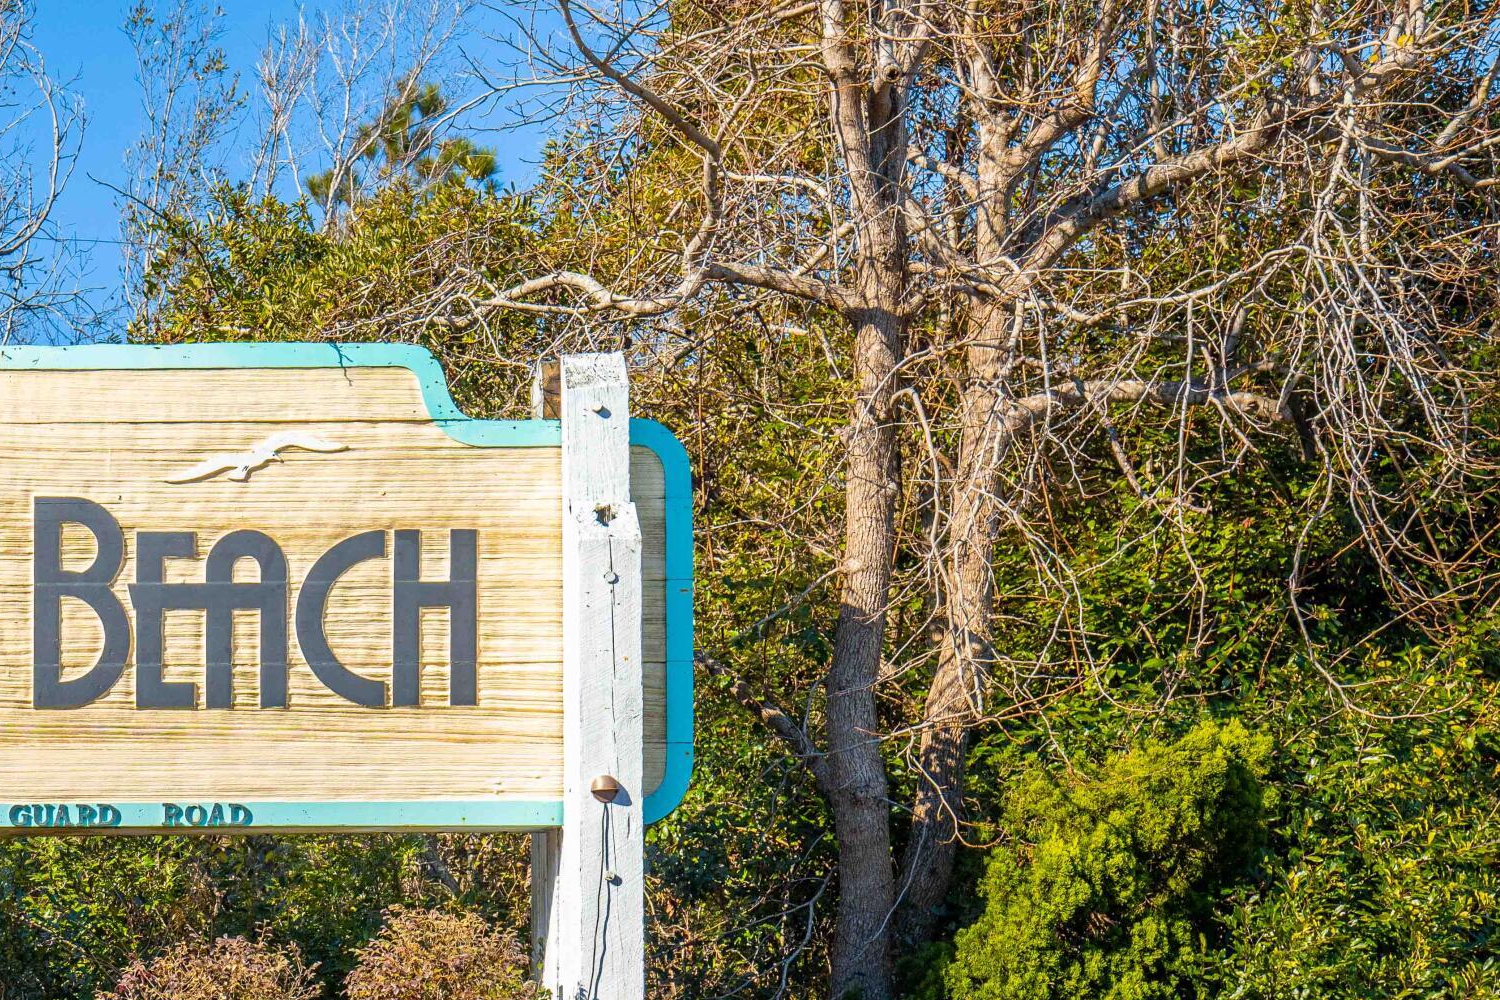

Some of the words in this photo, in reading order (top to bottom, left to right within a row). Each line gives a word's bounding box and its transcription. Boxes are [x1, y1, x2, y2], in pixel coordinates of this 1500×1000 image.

[33, 495, 478, 710] BEACH
[8, 803, 122, 828] GUARD
[161, 802, 254, 828] ROAD
